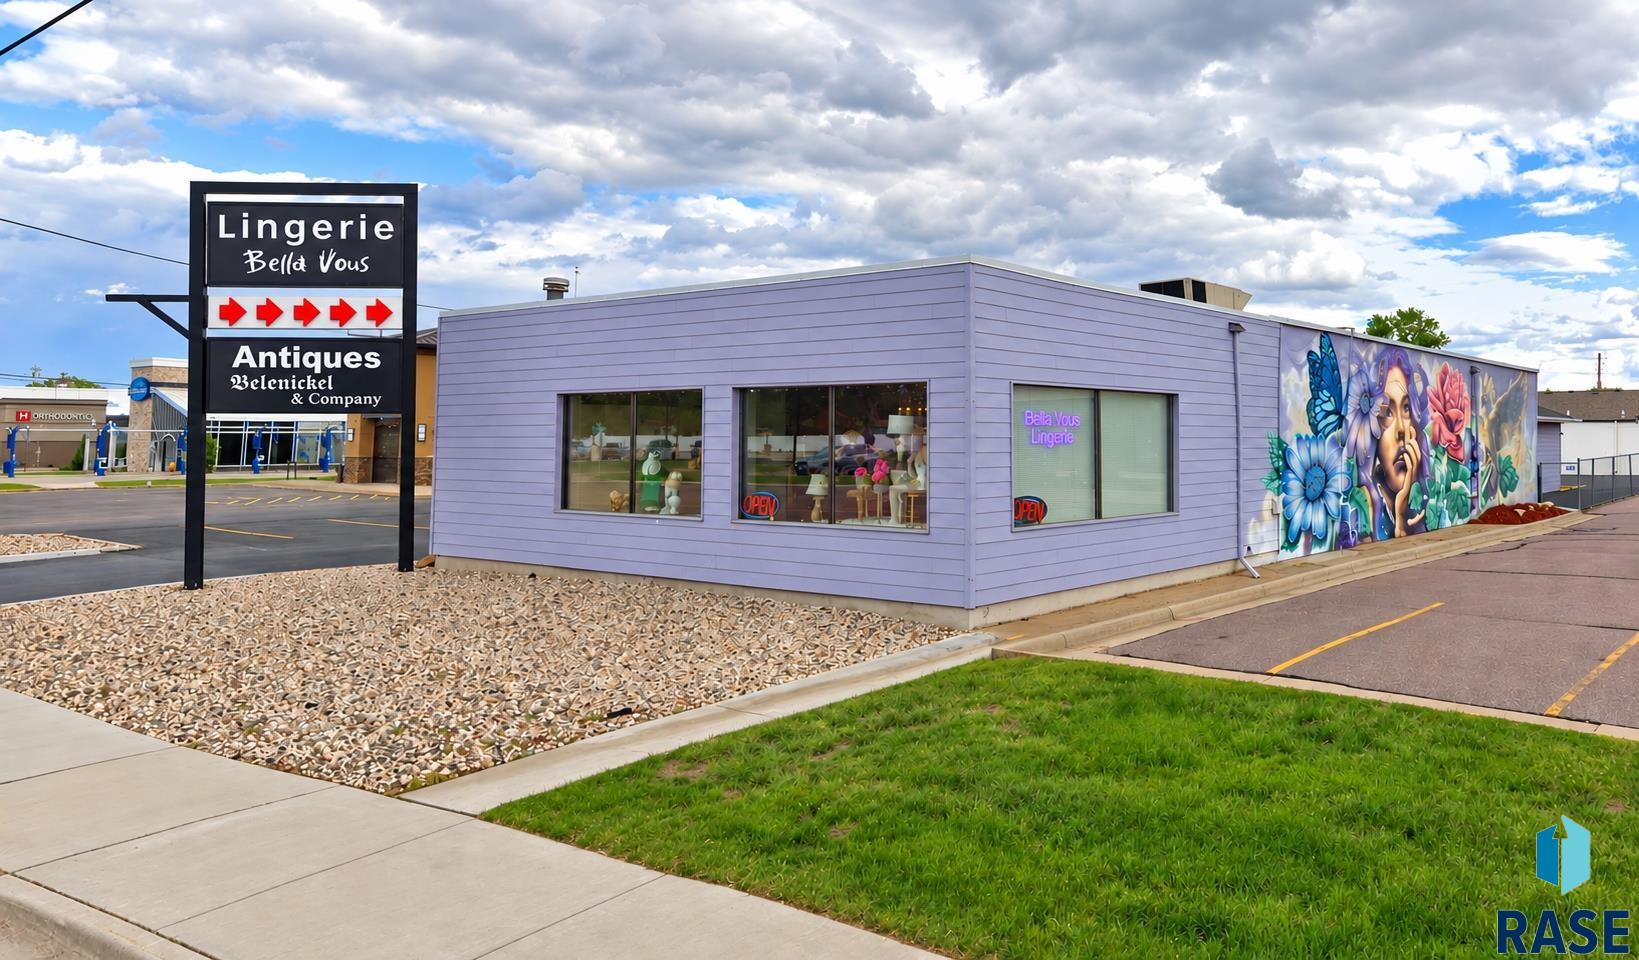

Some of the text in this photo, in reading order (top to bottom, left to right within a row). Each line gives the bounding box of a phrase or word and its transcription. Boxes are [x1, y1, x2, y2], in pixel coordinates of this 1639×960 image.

[218, 212, 395, 247] Lingerie
[242, 248, 370, 275] Bella Vous
[231, 345, 382, 374] Antiques
[230, 374, 334, 391] Belenickel
[291, 392, 382, 408] & Company
[1024, 410, 1081, 427] Bella Vous
[1031, 428, 1074, 448] Lingerie
[743, 495, 776, 517] OPEN
